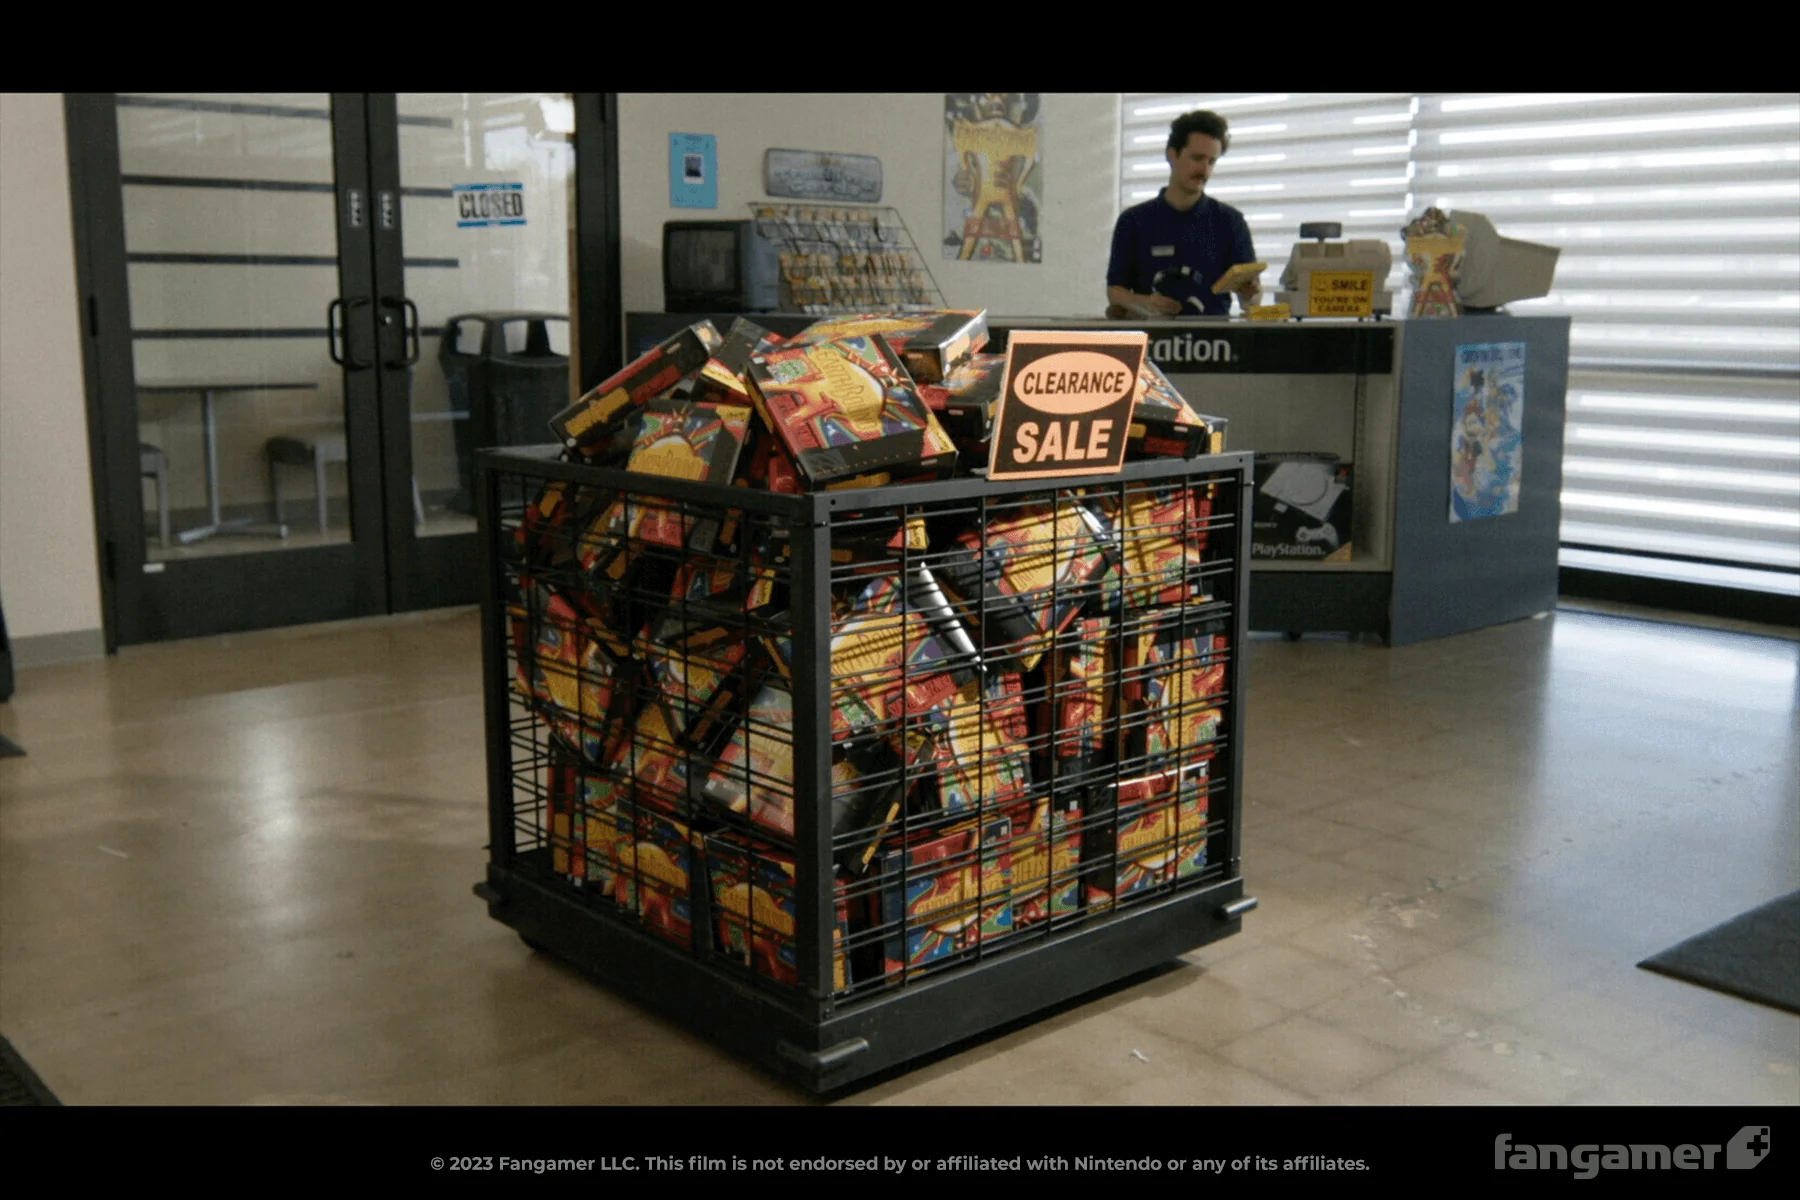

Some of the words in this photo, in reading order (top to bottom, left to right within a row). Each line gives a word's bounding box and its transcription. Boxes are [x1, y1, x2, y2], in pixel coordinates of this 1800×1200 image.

[458, 191, 525, 219] CLOSED
[1332, 279, 1368, 291] SMILE
[1022, 371, 1126, 395] CLEARANCE
[1012, 419, 1113, 464] SALE
[1252, 542, 1323, 558] PlayStation
